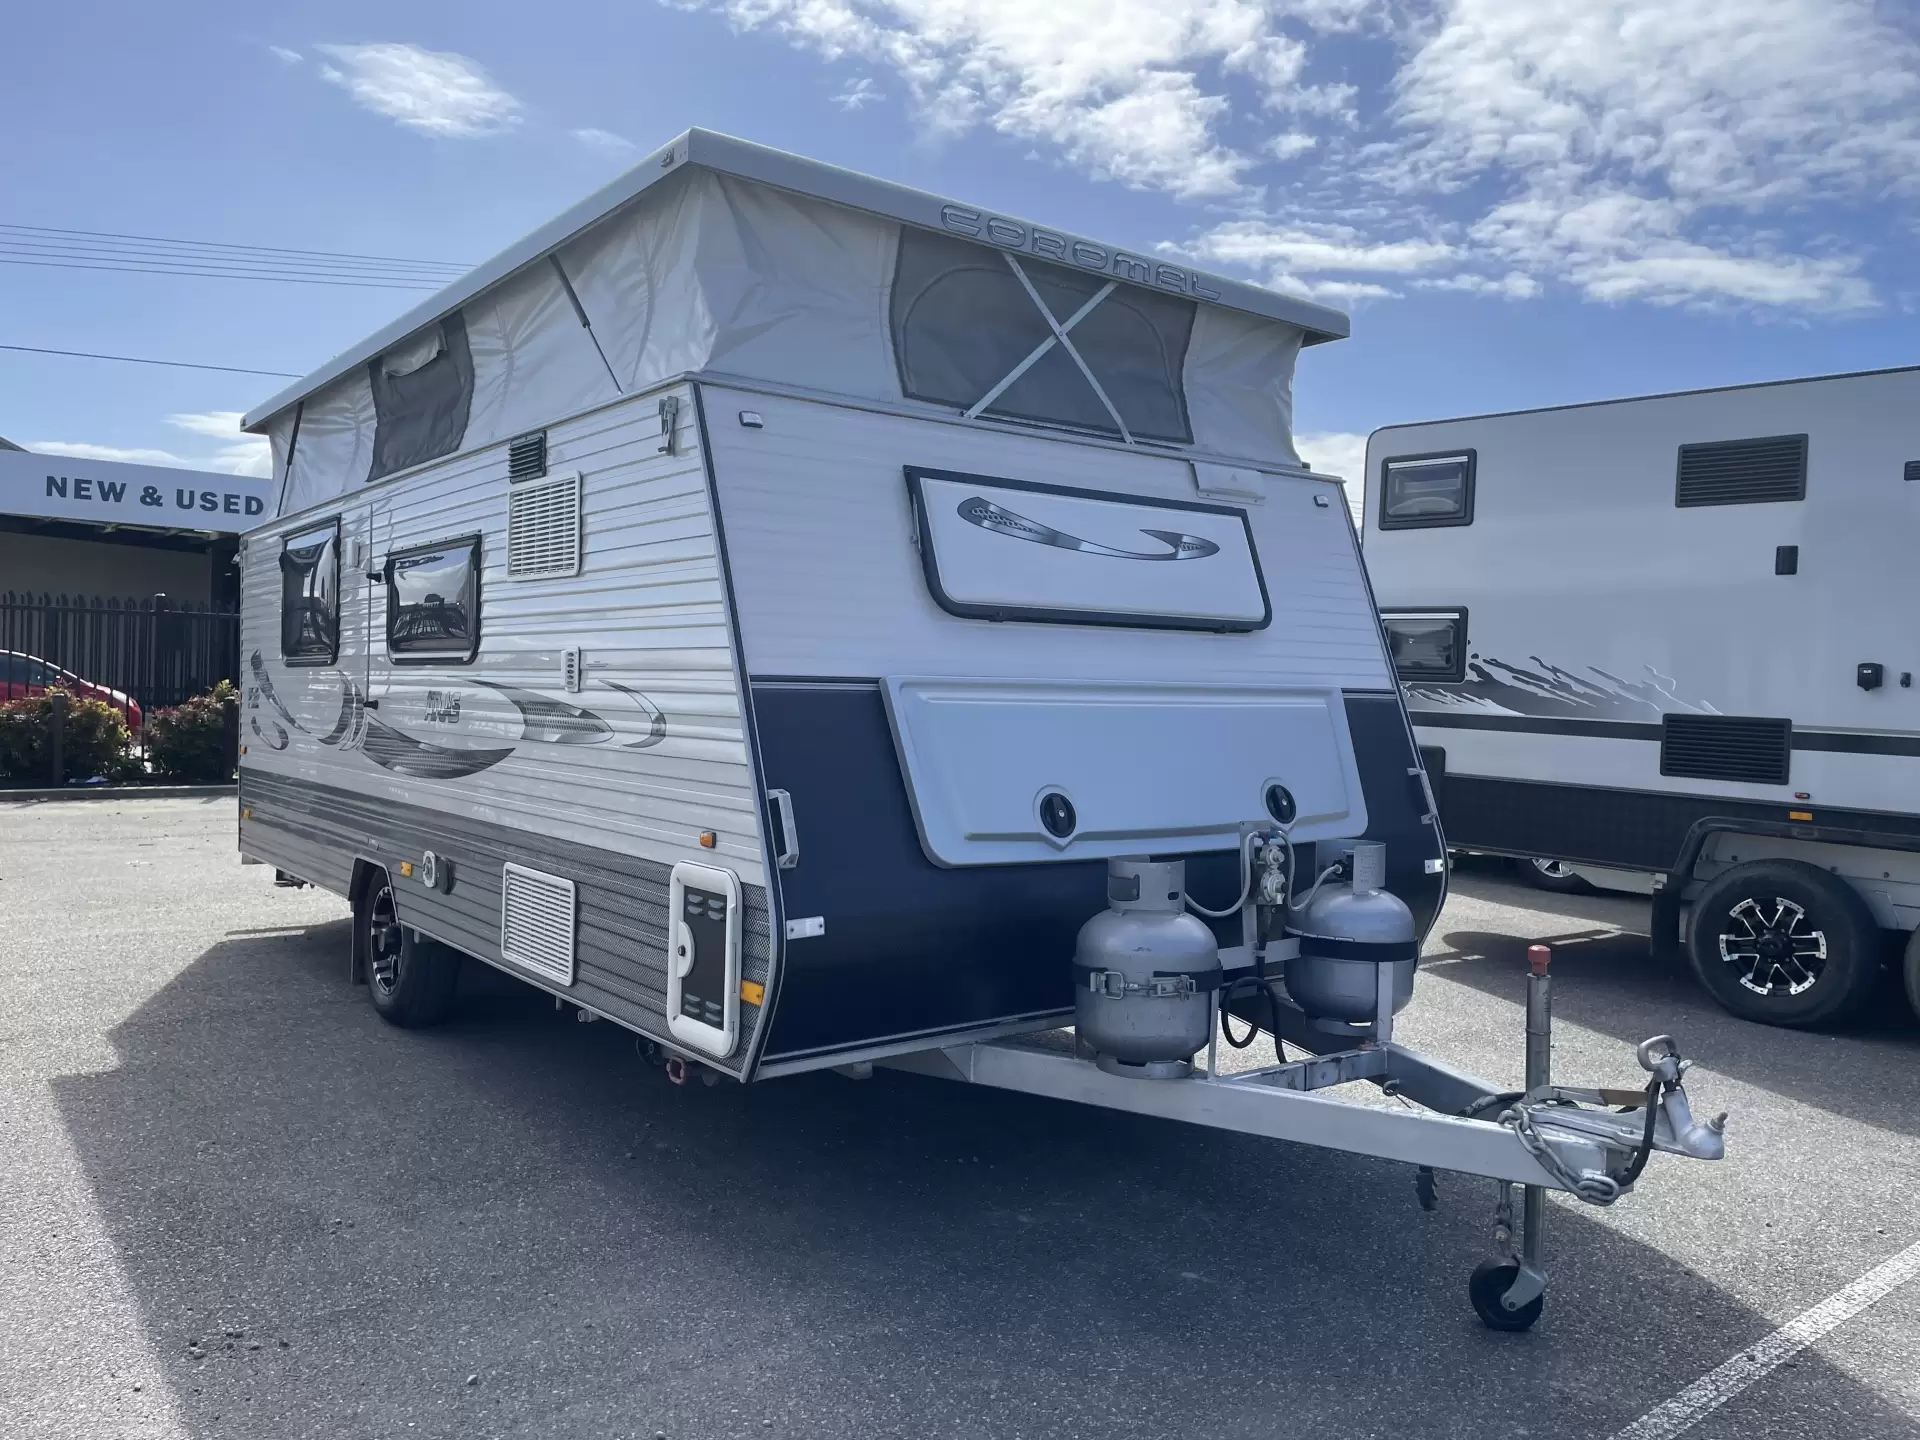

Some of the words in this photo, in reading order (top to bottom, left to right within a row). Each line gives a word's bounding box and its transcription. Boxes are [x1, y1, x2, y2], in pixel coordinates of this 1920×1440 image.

[941, 204, 1221, 300] COROMAL
[46, 475, 127, 503] NEW
[139, 485, 164, 508] &
[176, 488, 265, 516] USED
